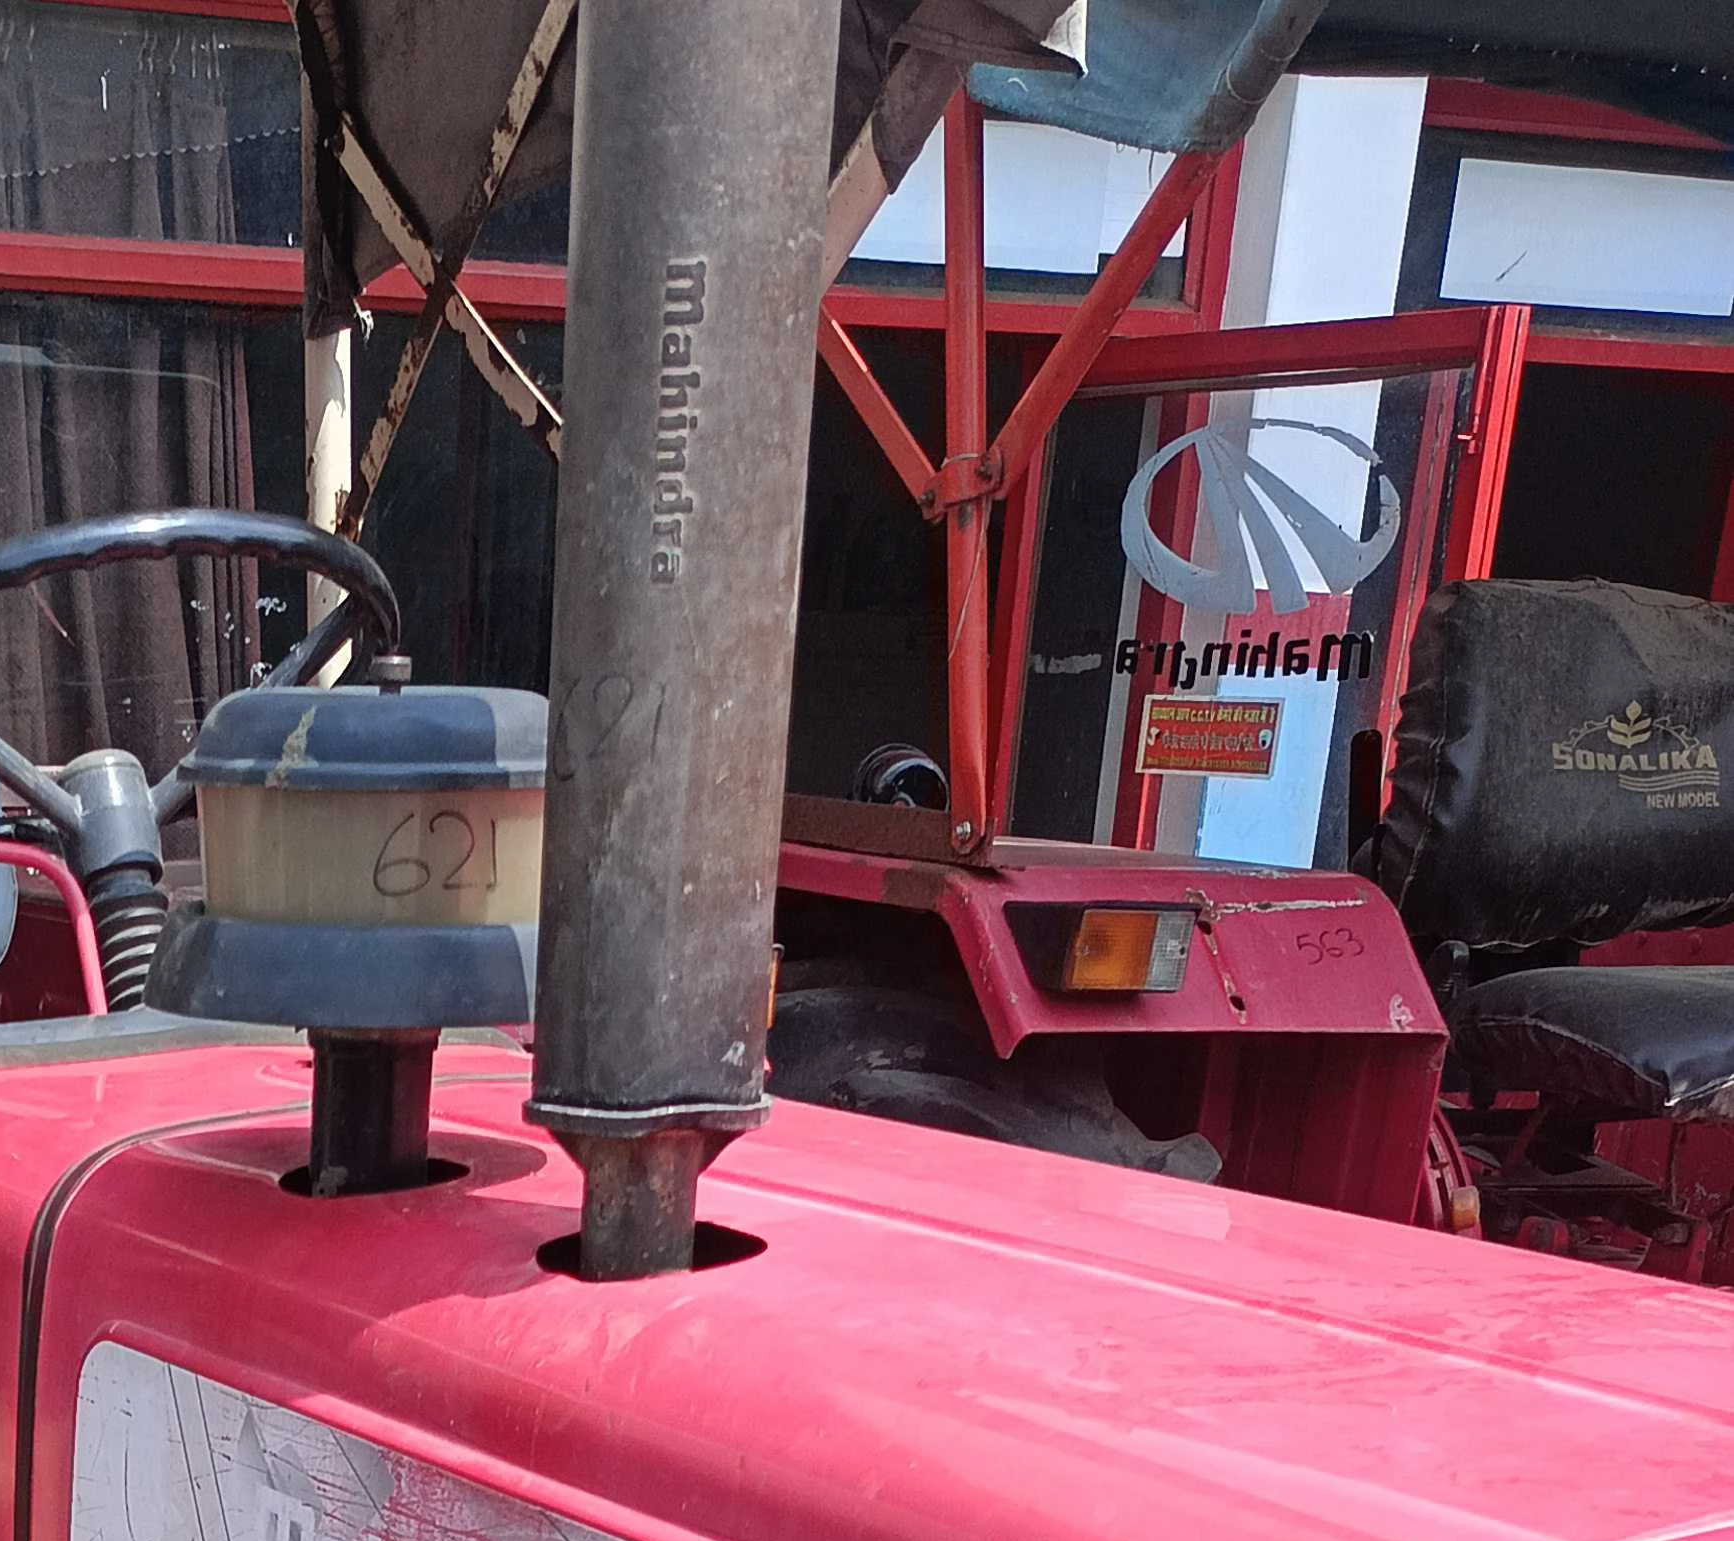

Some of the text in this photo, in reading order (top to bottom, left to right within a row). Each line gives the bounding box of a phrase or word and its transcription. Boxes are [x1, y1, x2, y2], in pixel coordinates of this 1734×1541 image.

[1552, 744, 1718, 771] SONALIKA
[1647, 791, 1720, 809] NEW MODEL
[373, 810, 498, 897] 621
[1296, 928, 1364, 965] 563
